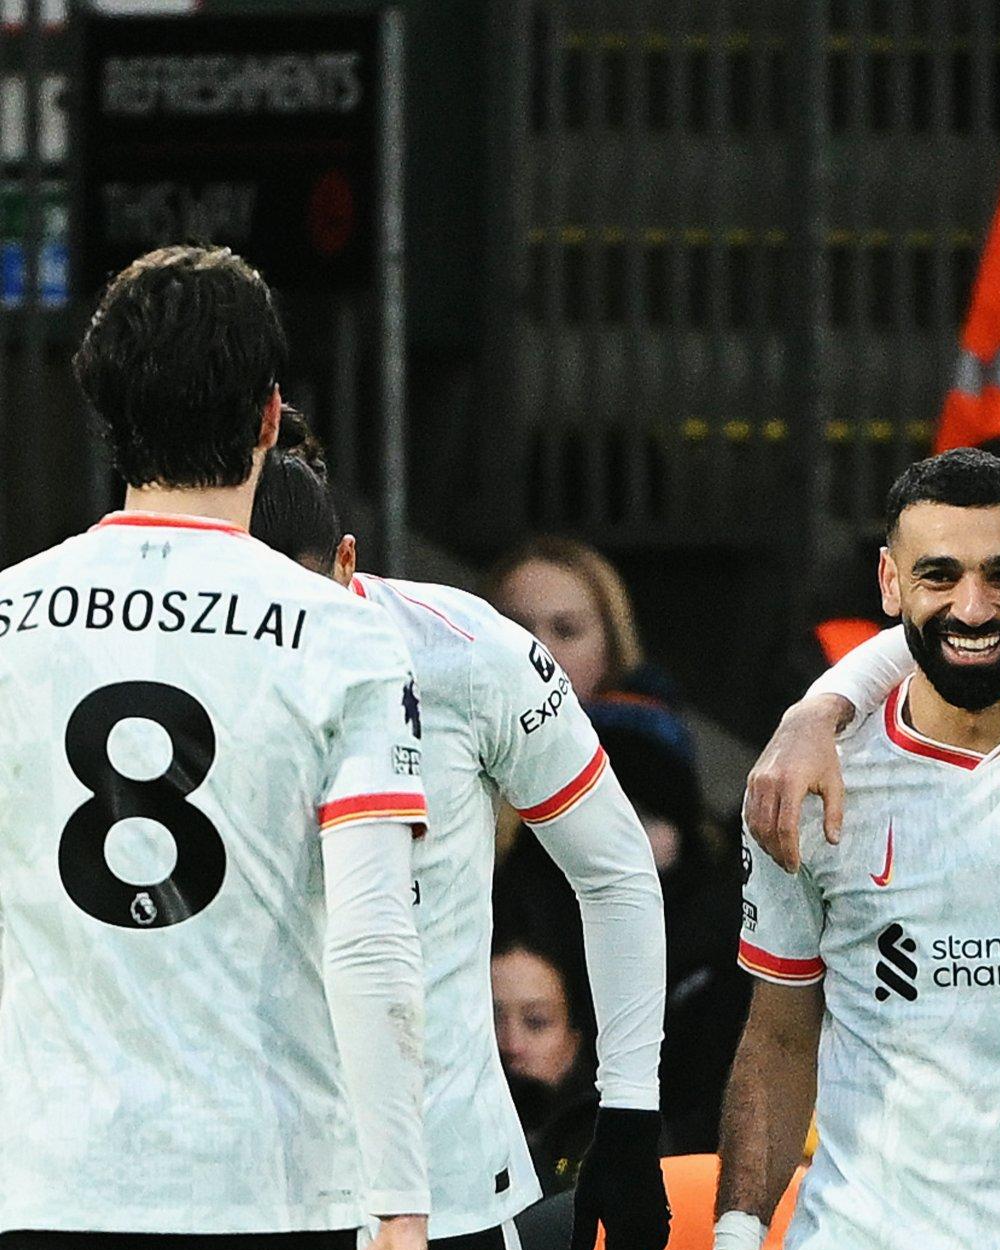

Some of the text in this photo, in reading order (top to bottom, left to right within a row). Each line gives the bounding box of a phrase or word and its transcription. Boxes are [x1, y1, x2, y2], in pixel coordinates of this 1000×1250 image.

[0, 586, 307, 650] SZOBOSZLAI
[519, 676, 570, 735] Expe
[57, 680, 227, 931] 8
